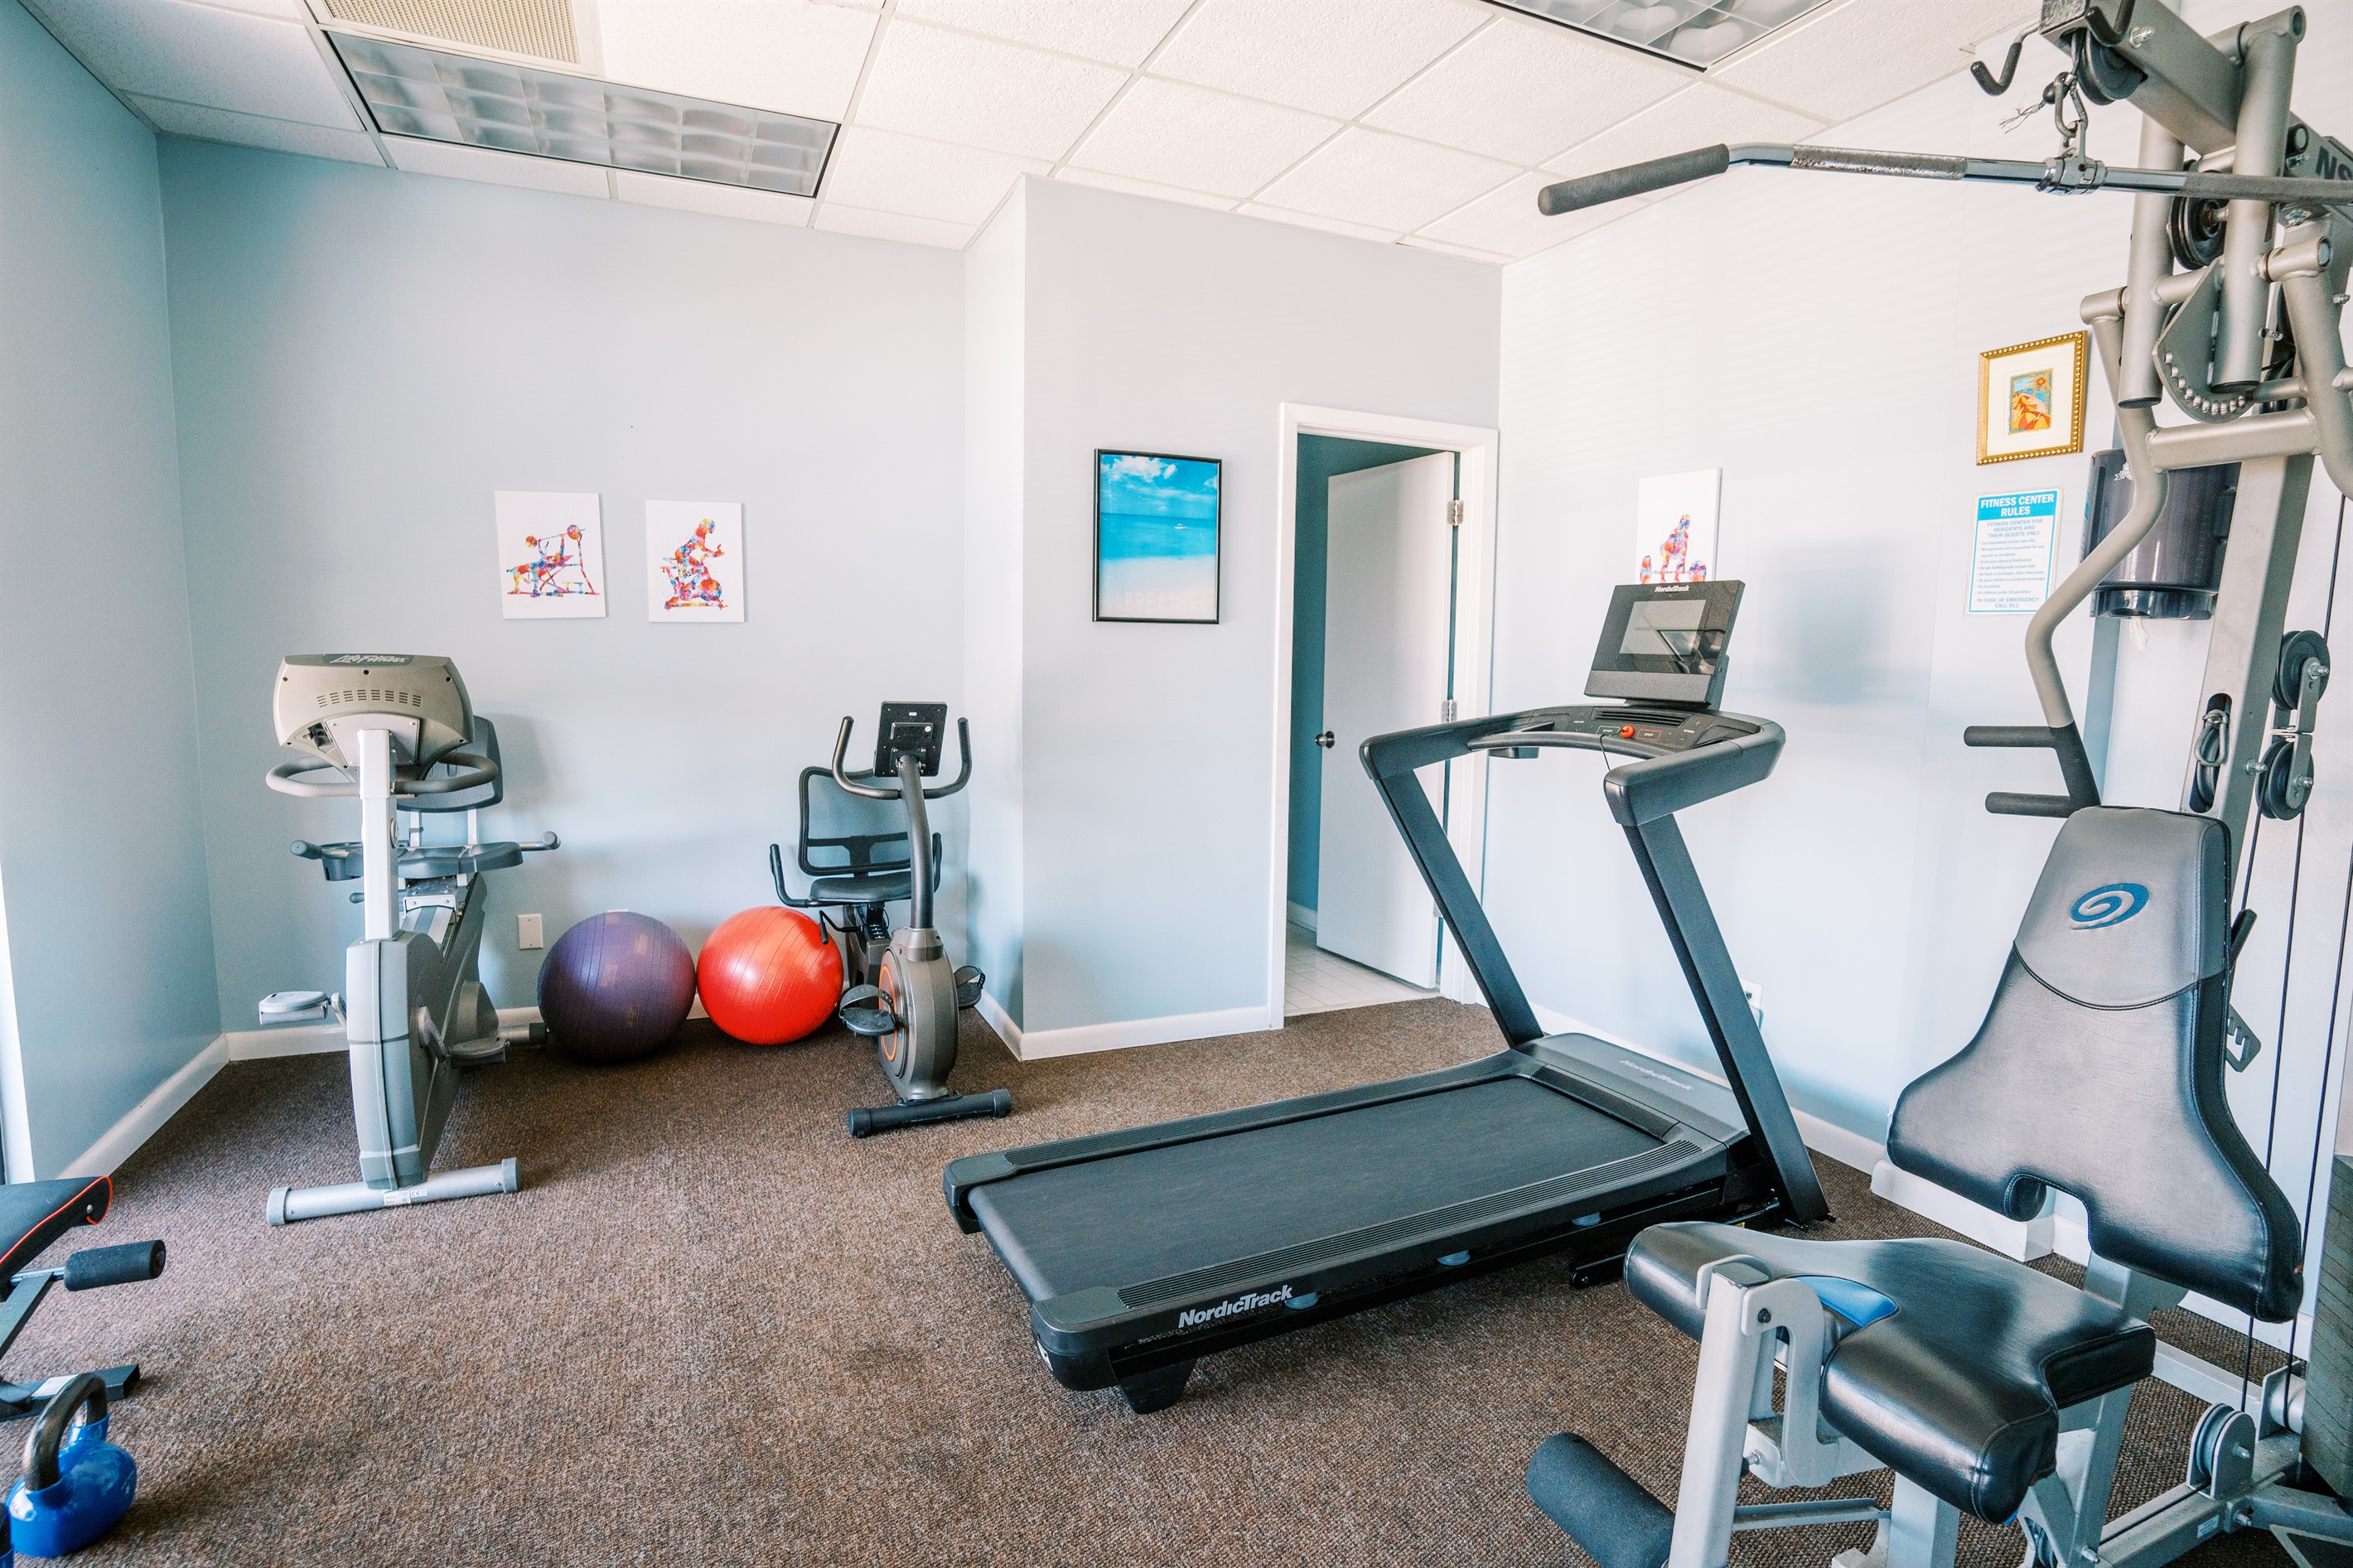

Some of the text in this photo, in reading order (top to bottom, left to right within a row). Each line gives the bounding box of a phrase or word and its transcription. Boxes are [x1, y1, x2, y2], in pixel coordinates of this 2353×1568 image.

[1980, 494, 2055, 509] FITNESS CENTER
[2001, 506, 2031, 517] RULES
[1177, 1284, 1292, 1329] NordicTrack
